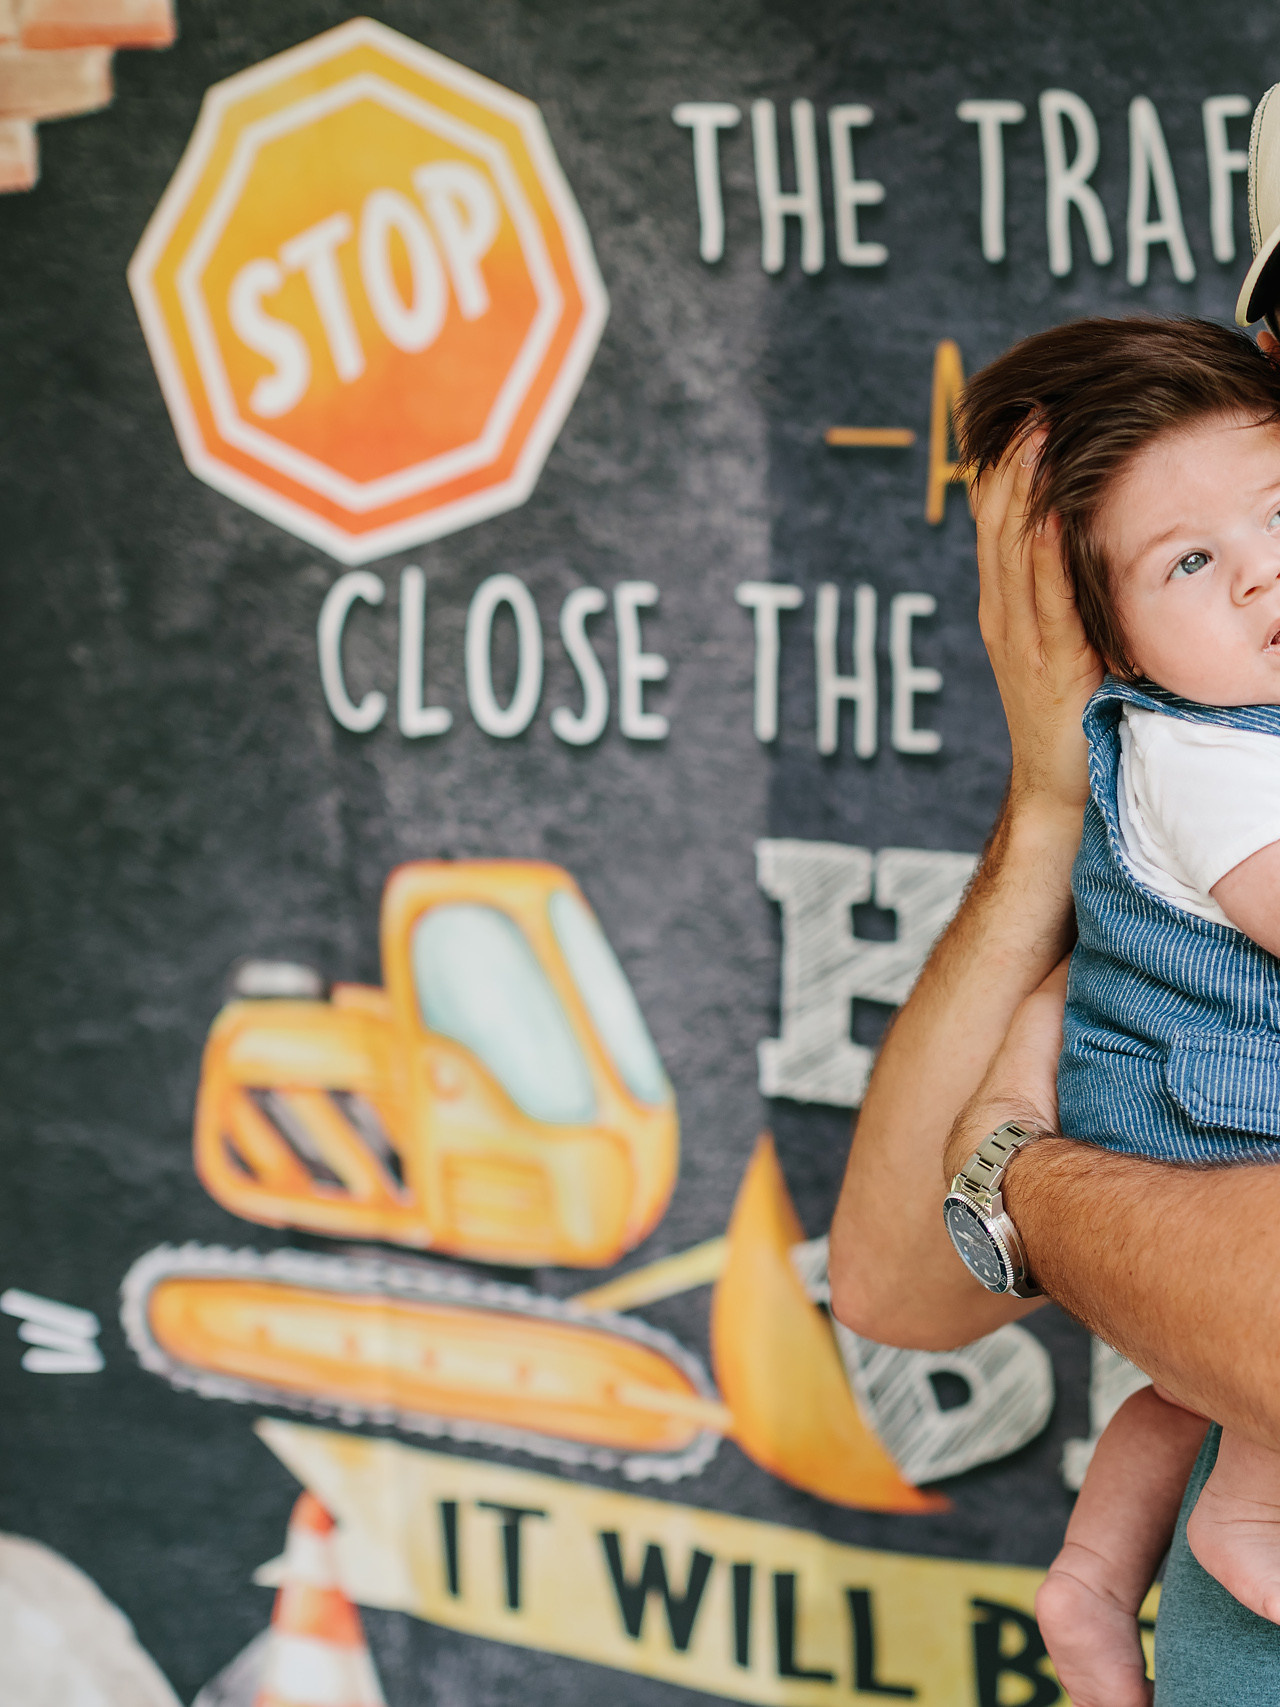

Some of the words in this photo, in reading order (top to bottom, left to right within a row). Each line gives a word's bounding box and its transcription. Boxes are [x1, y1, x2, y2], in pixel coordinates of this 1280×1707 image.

[672, 97, 889, 275] THE
[228, 160, 502, 418] STOP
[318, 566, 670, 746] CLOSE
[734, 580, 945, 760] THE
[436, 1498, 550, 1613] IT
[599, 1526, 917, 1699] WILL
